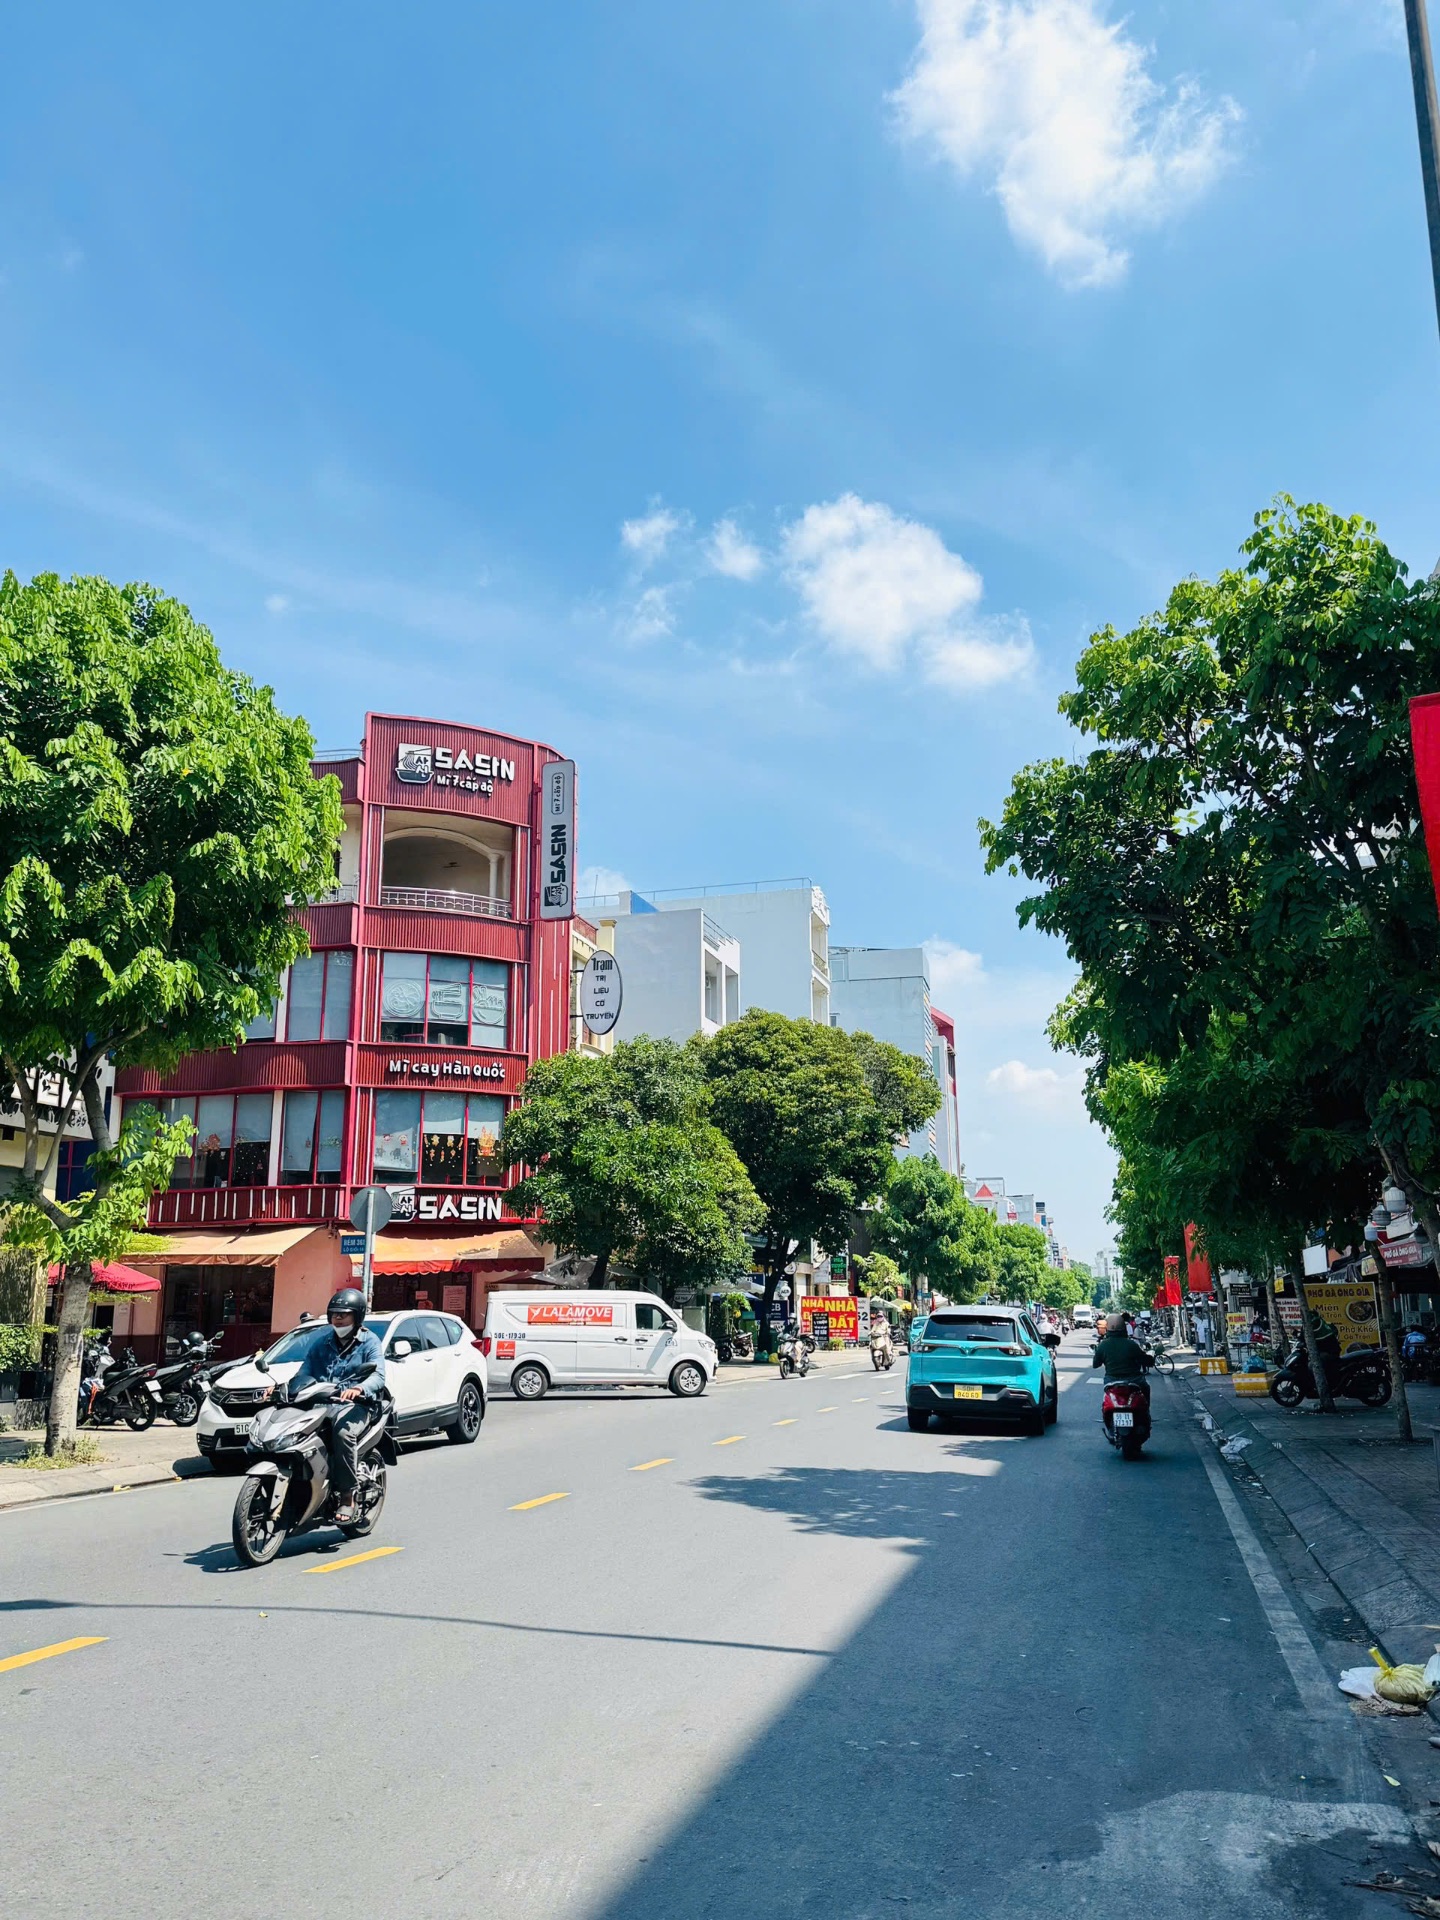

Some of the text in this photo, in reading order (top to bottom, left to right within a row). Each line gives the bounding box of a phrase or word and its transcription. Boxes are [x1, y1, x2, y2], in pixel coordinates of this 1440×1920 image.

[435, 747, 515, 781] SASIN
[437, 775, 493, 797] Mì 7 cấp độ
[550, 824, 566, 883] SASIN
[591, 957, 613, 972] Trạm
[389, 1059, 506, 1078] Mì cay Hàn Quốc
[418, 1195, 502, 1220] SASIN
[542, 1307, 612, 1318] LALAMOVE
[802, 1298, 824, 1307] NHÀ
[824, 1298, 857, 1312] NHÀ
[829, 1314, 856, 1329] ĐẤT
